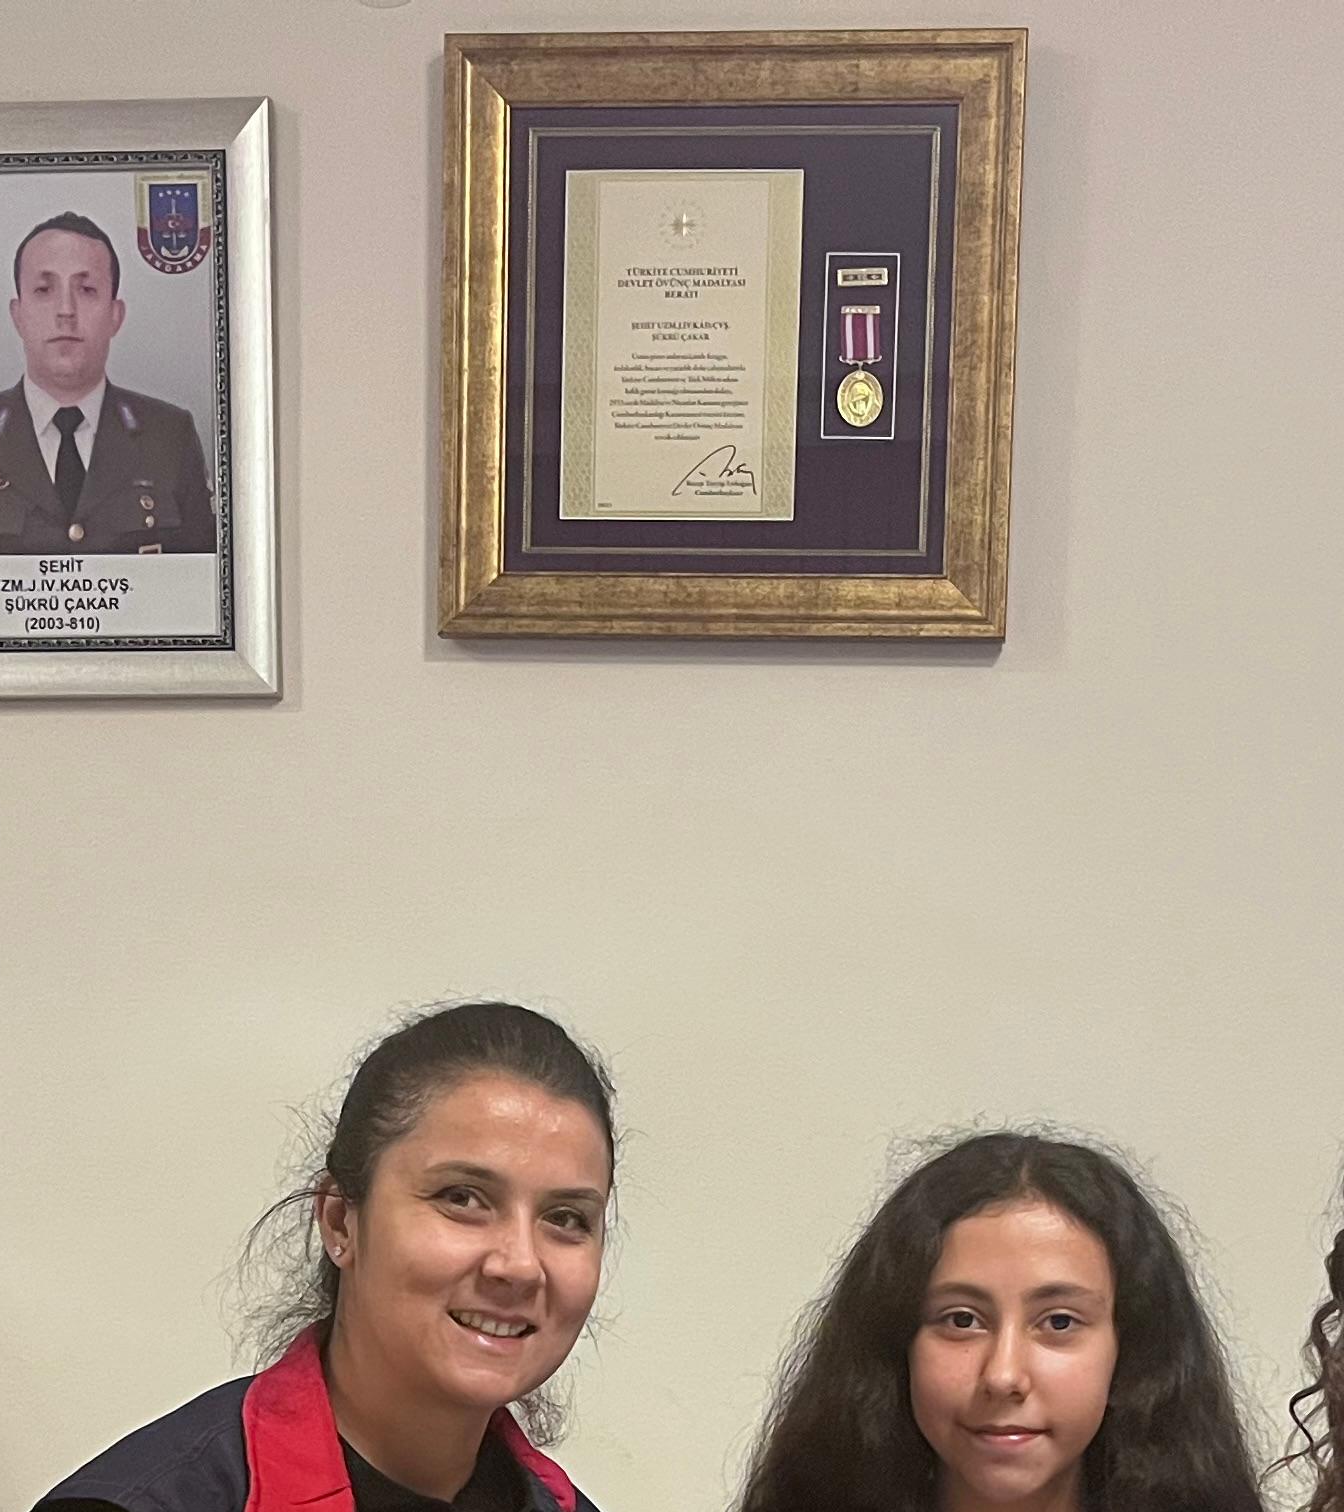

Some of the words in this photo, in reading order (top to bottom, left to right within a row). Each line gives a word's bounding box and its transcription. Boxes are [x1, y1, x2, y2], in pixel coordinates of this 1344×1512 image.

[617, 279, 654, 288] DEVLET
[39, 557, 84, 575] ŞEHİT
[5, 595, 59, 614] ŞÜKRÜ
[64, 597, 119, 613] ÇAKAR
[24, 616, 100, 633] (2003-810)
